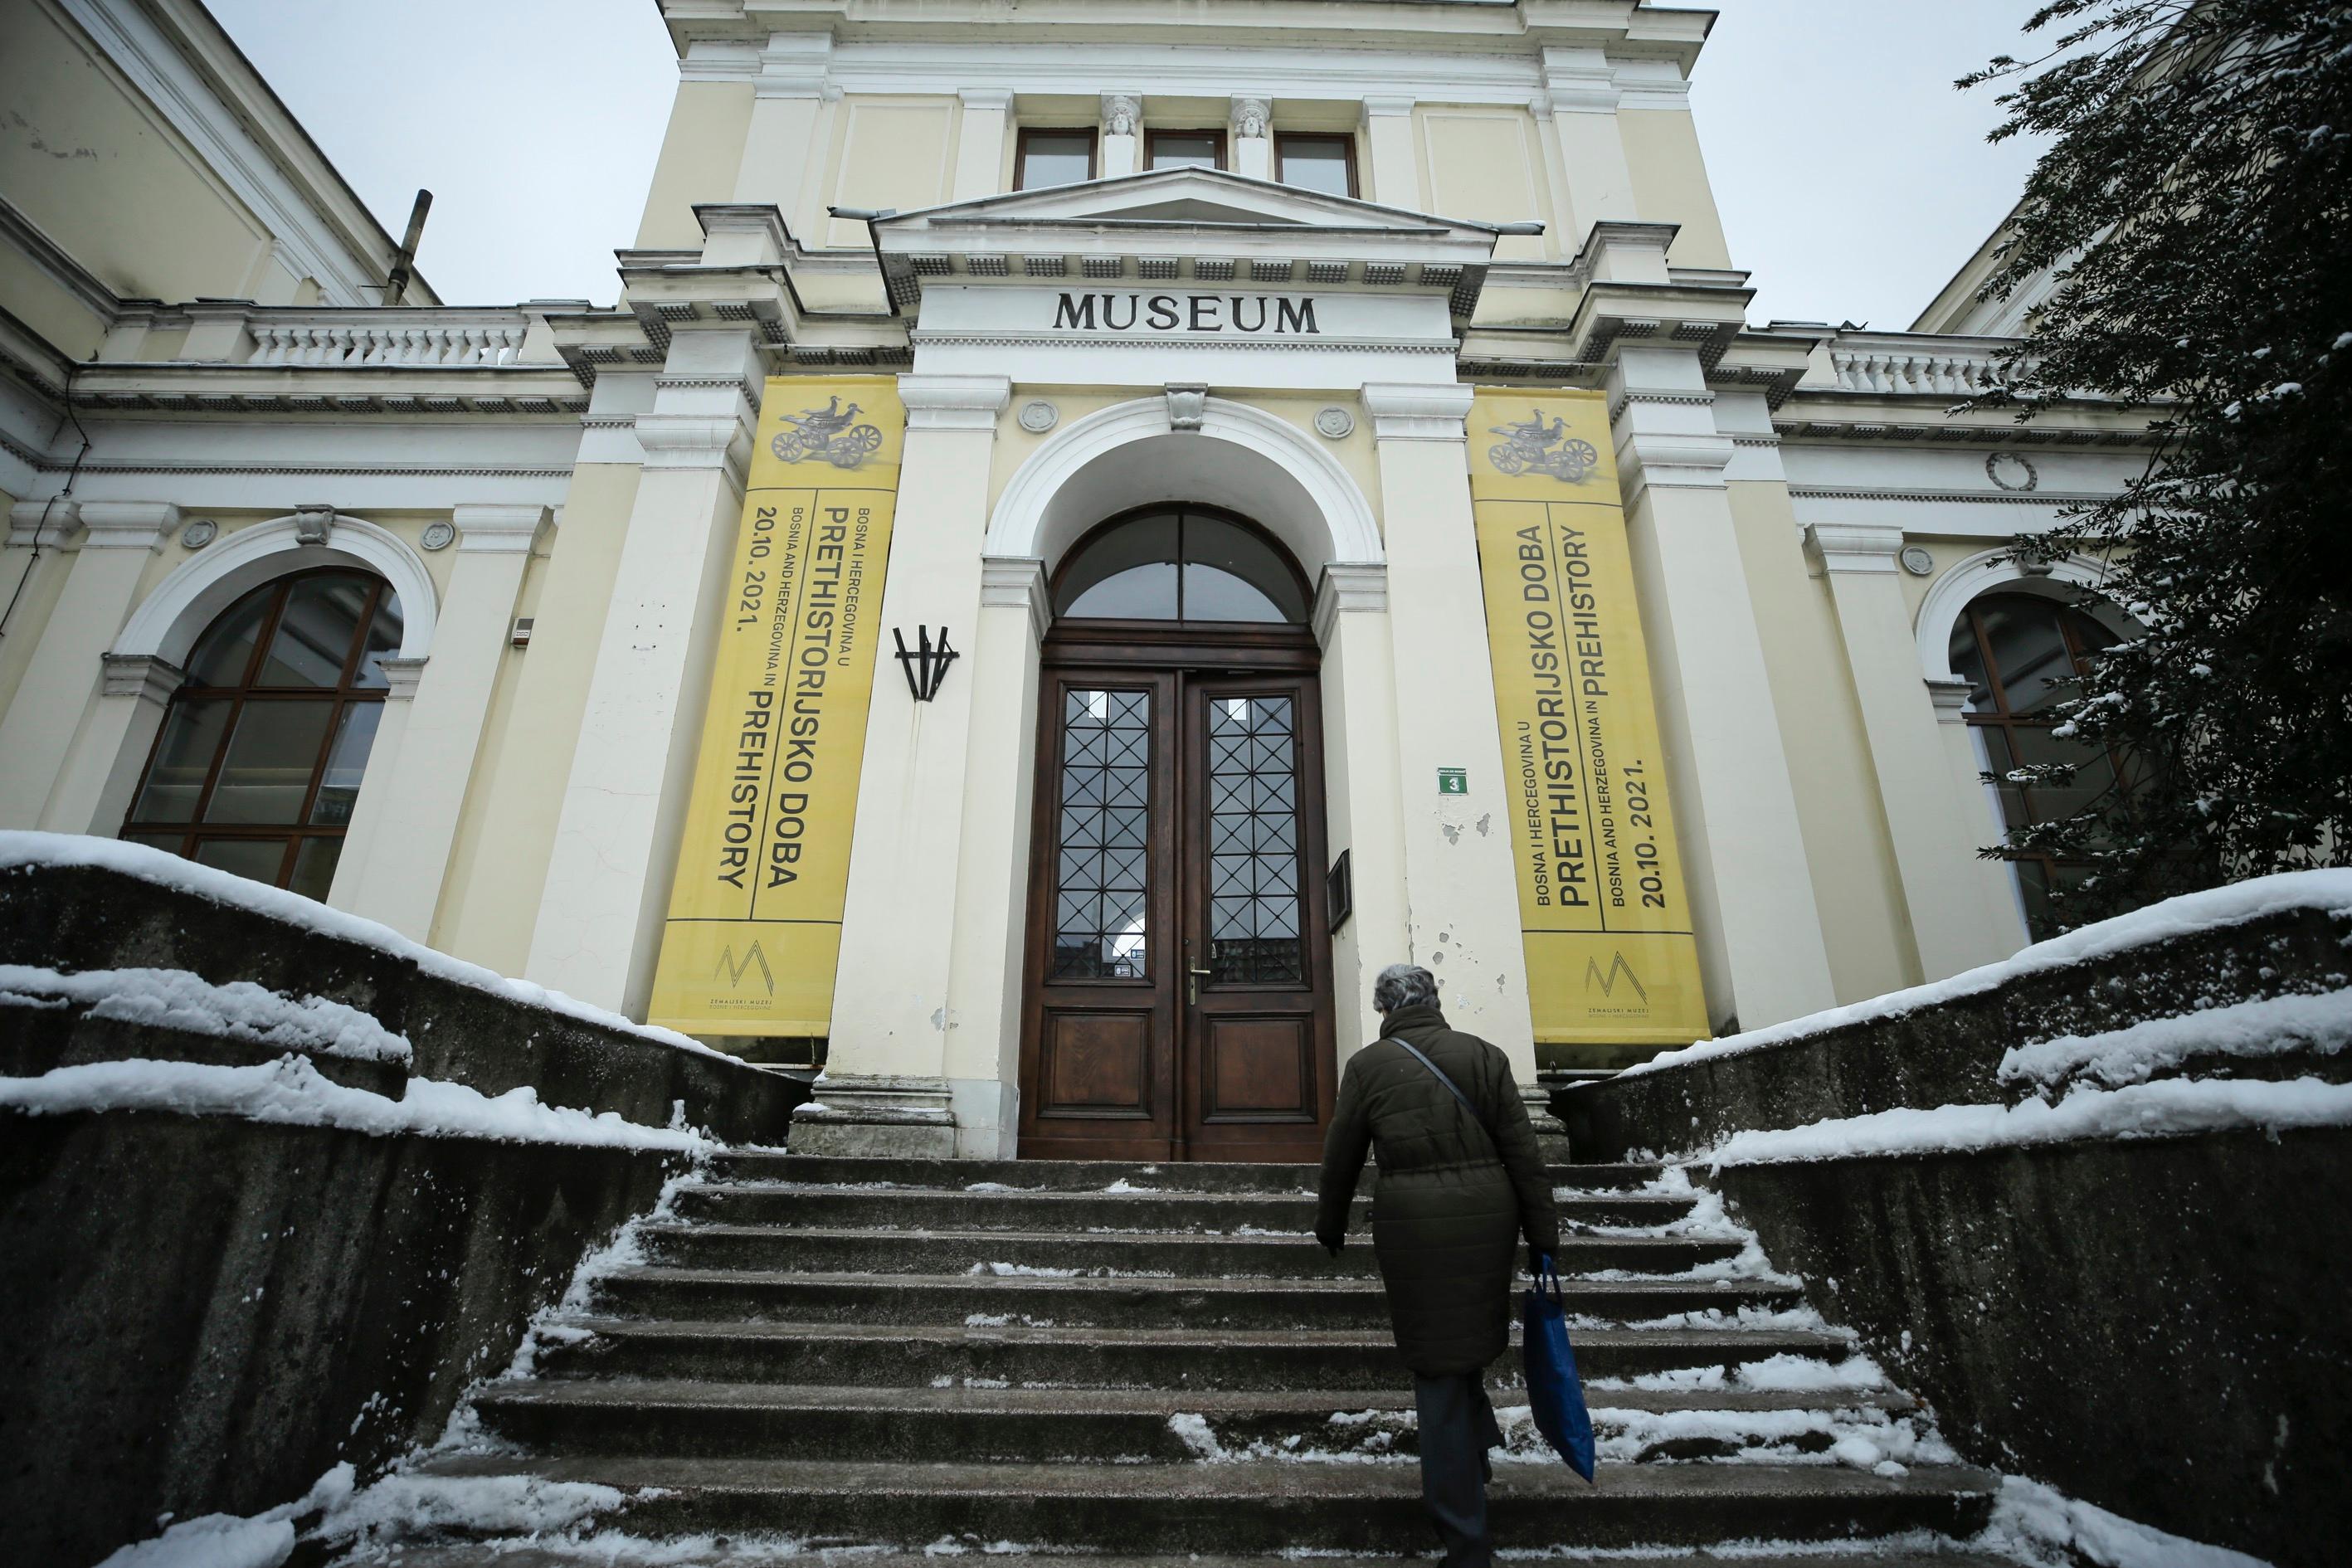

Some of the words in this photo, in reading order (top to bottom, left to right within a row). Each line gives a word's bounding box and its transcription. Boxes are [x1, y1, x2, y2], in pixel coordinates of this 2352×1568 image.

[1052, 292, 1320, 334] MUSEUM
[747, 507, 777, 565] 20.10.
[786, 507, 803, 550] BOSNIA
[853, 507, 869, 551] BOSNA
[782, 553, 796, 579] AND
[1517, 524, 1551, 602] DOBA
[736, 570, 767, 632] 2021.
[766, 581, 791, 670] HERZEGOVINA
[838, 560, 864, 655] HERCEGOVINA
[1561, 524, 1609, 697] PREHISTORY
[783, 508, 849, 783] PRETHISTORIJSKO
[837, 657, 850, 667] U
[763, 673, 777, 687] IN
[1584, 700, 1599, 714] IN
[1517, 721, 1531, 731] U
[1449, 778, 1458, 790] 3
[1519, 733, 1543, 840] HERCEGOVINA
[1526, 611, 1589, 907] PRETHISTORIJSKO
[1587, 716, 1613, 815] HERZEGOVINA
[717, 691, 773, 890] PREHISTORY
[1622, 759, 1653, 829] 2021.
[767, 792, 808, 889] DOBA
[1602, 818, 1617, 848] AND
[1531, 851, 1551, 907] BOSNA
[1605, 851, 1625, 907] BOSNIA
[1634, 835, 1666, 909] 20.10.
